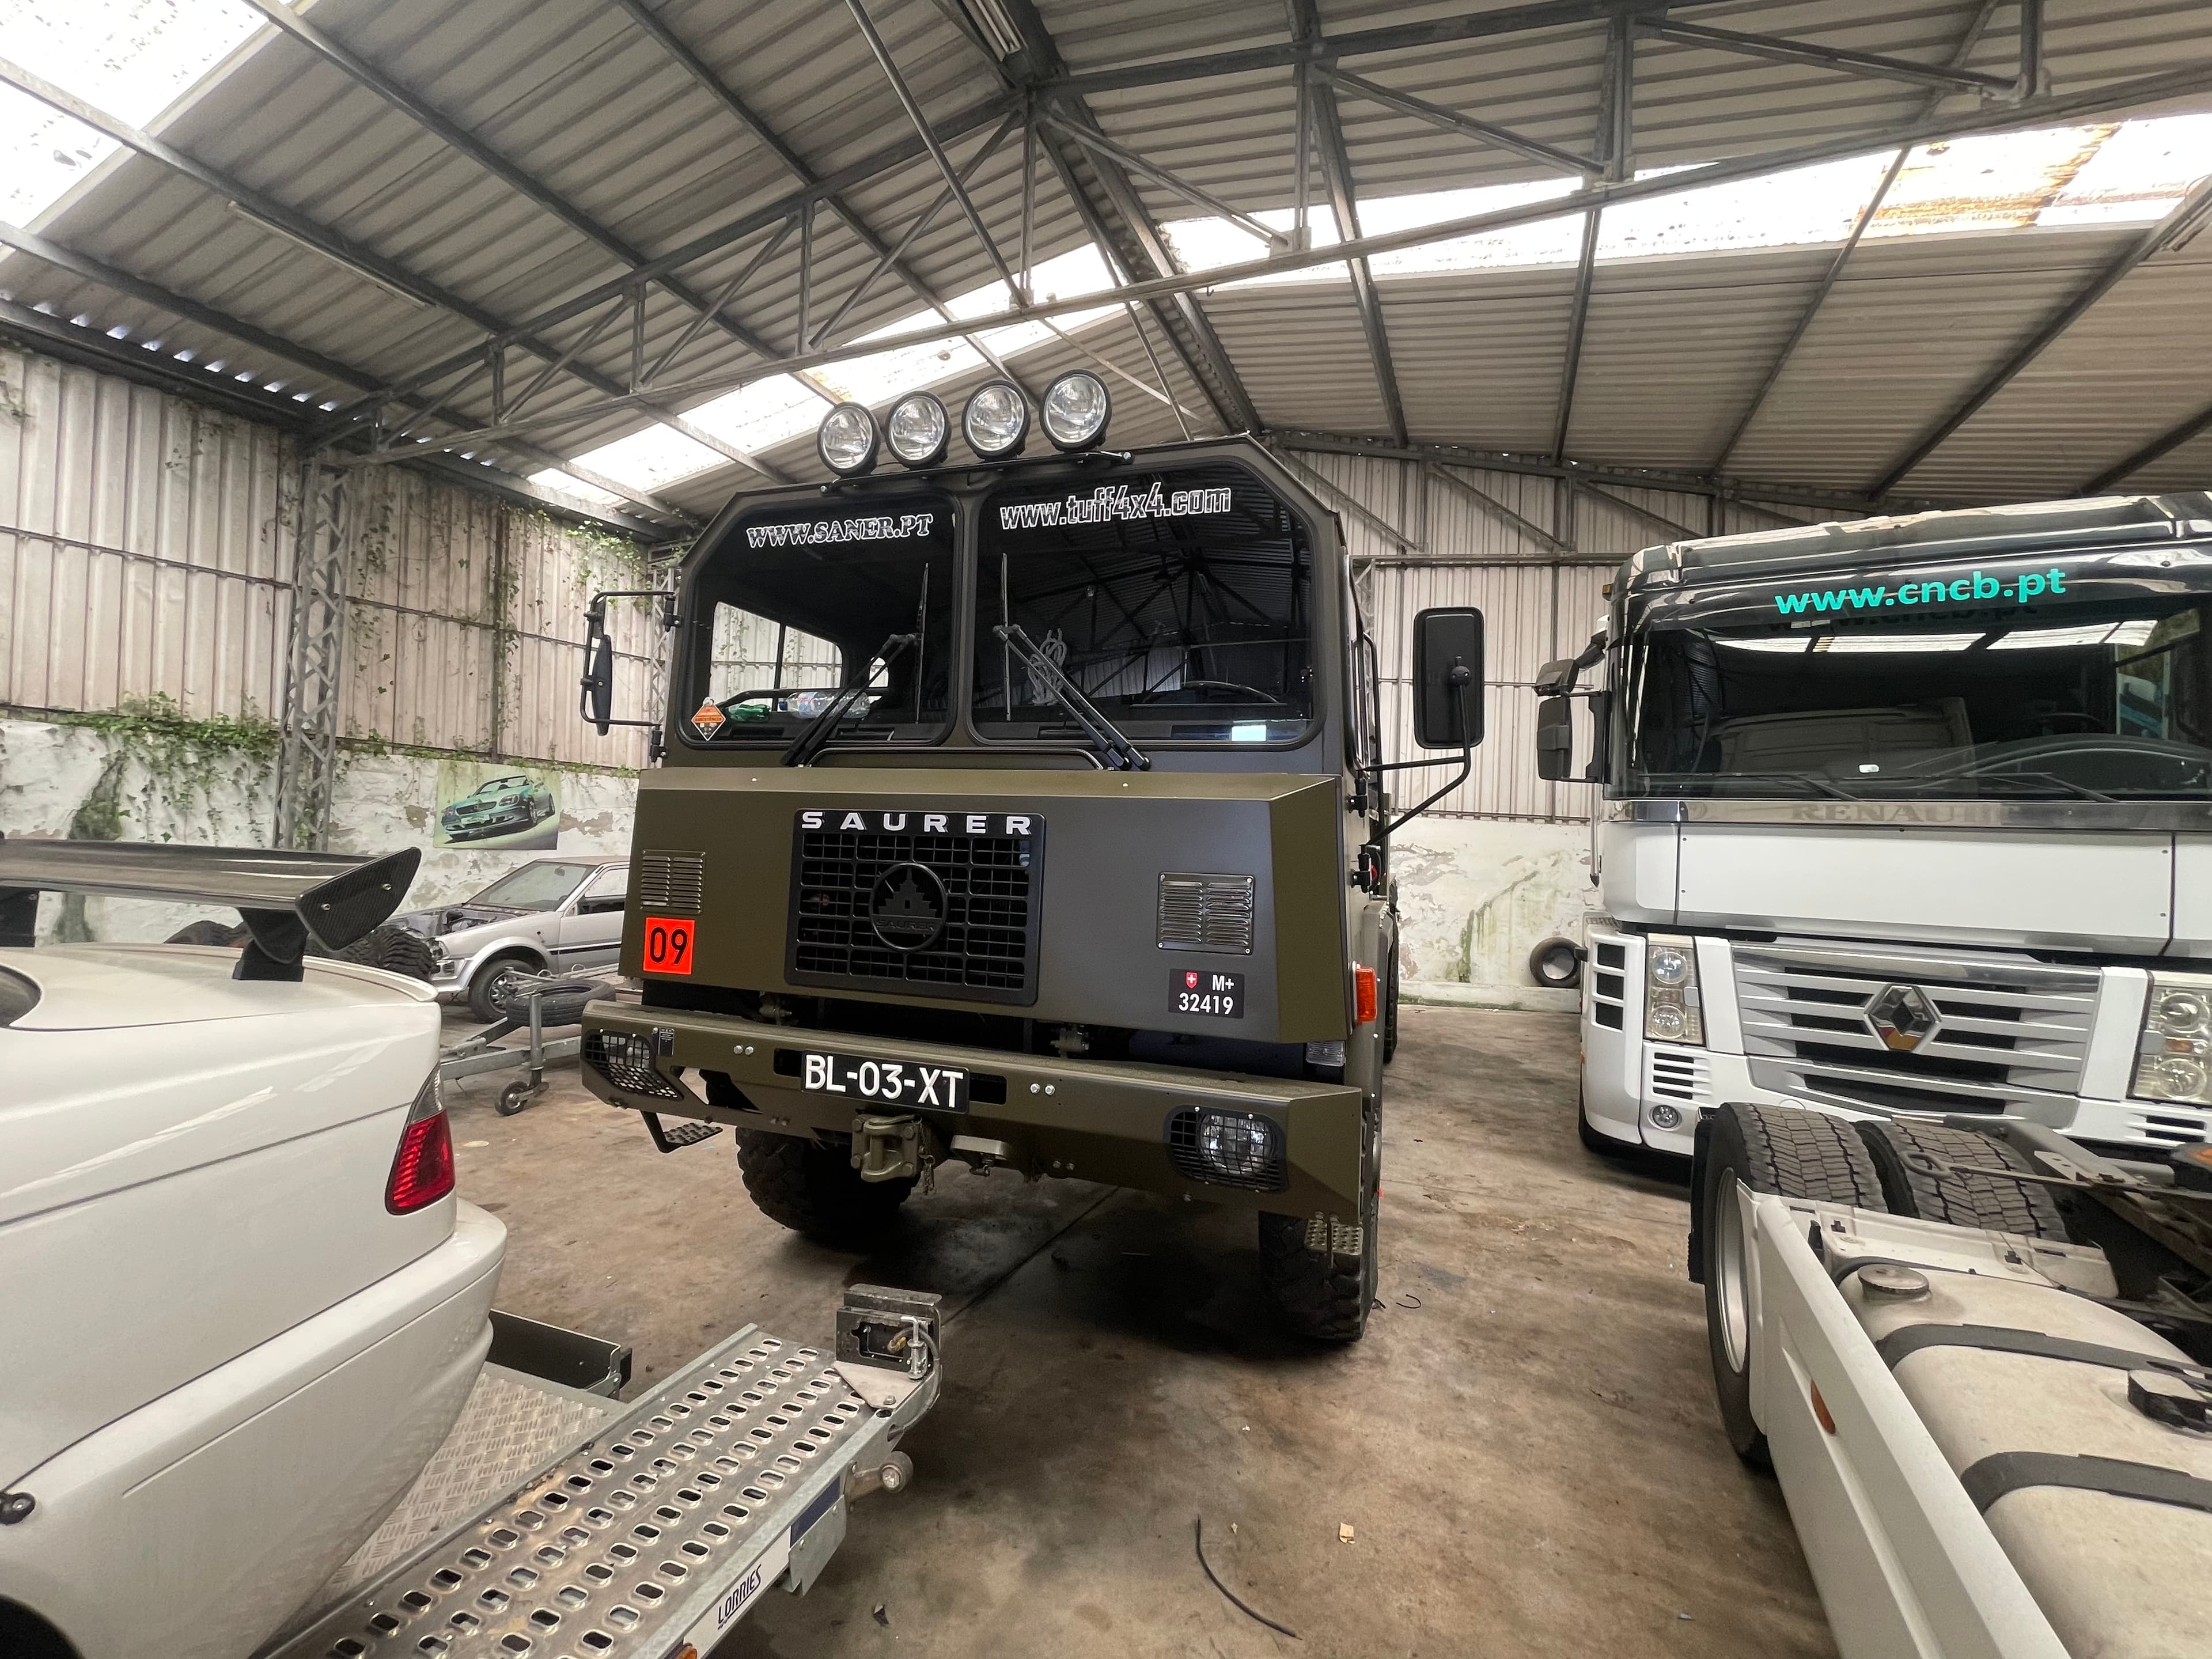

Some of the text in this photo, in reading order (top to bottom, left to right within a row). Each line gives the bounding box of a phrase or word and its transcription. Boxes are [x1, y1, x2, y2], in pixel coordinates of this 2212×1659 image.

[1000, 482, 1231, 529] www.tuff4x4.com
[747, 514, 933, 548] WWW.SANER.PT
[1774, 568, 2066, 614] www.cncb.pt
[801, 812, 1032, 835] SAURER
[1791, 804, 2019, 824] RENAU
[650, 927, 688, 965] 09
[1179, 993, 1233, 1014] 32419
[805, 1054, 964, 1108] BL-03-XT
[718, 1563, 762, 1626] LORRIES
